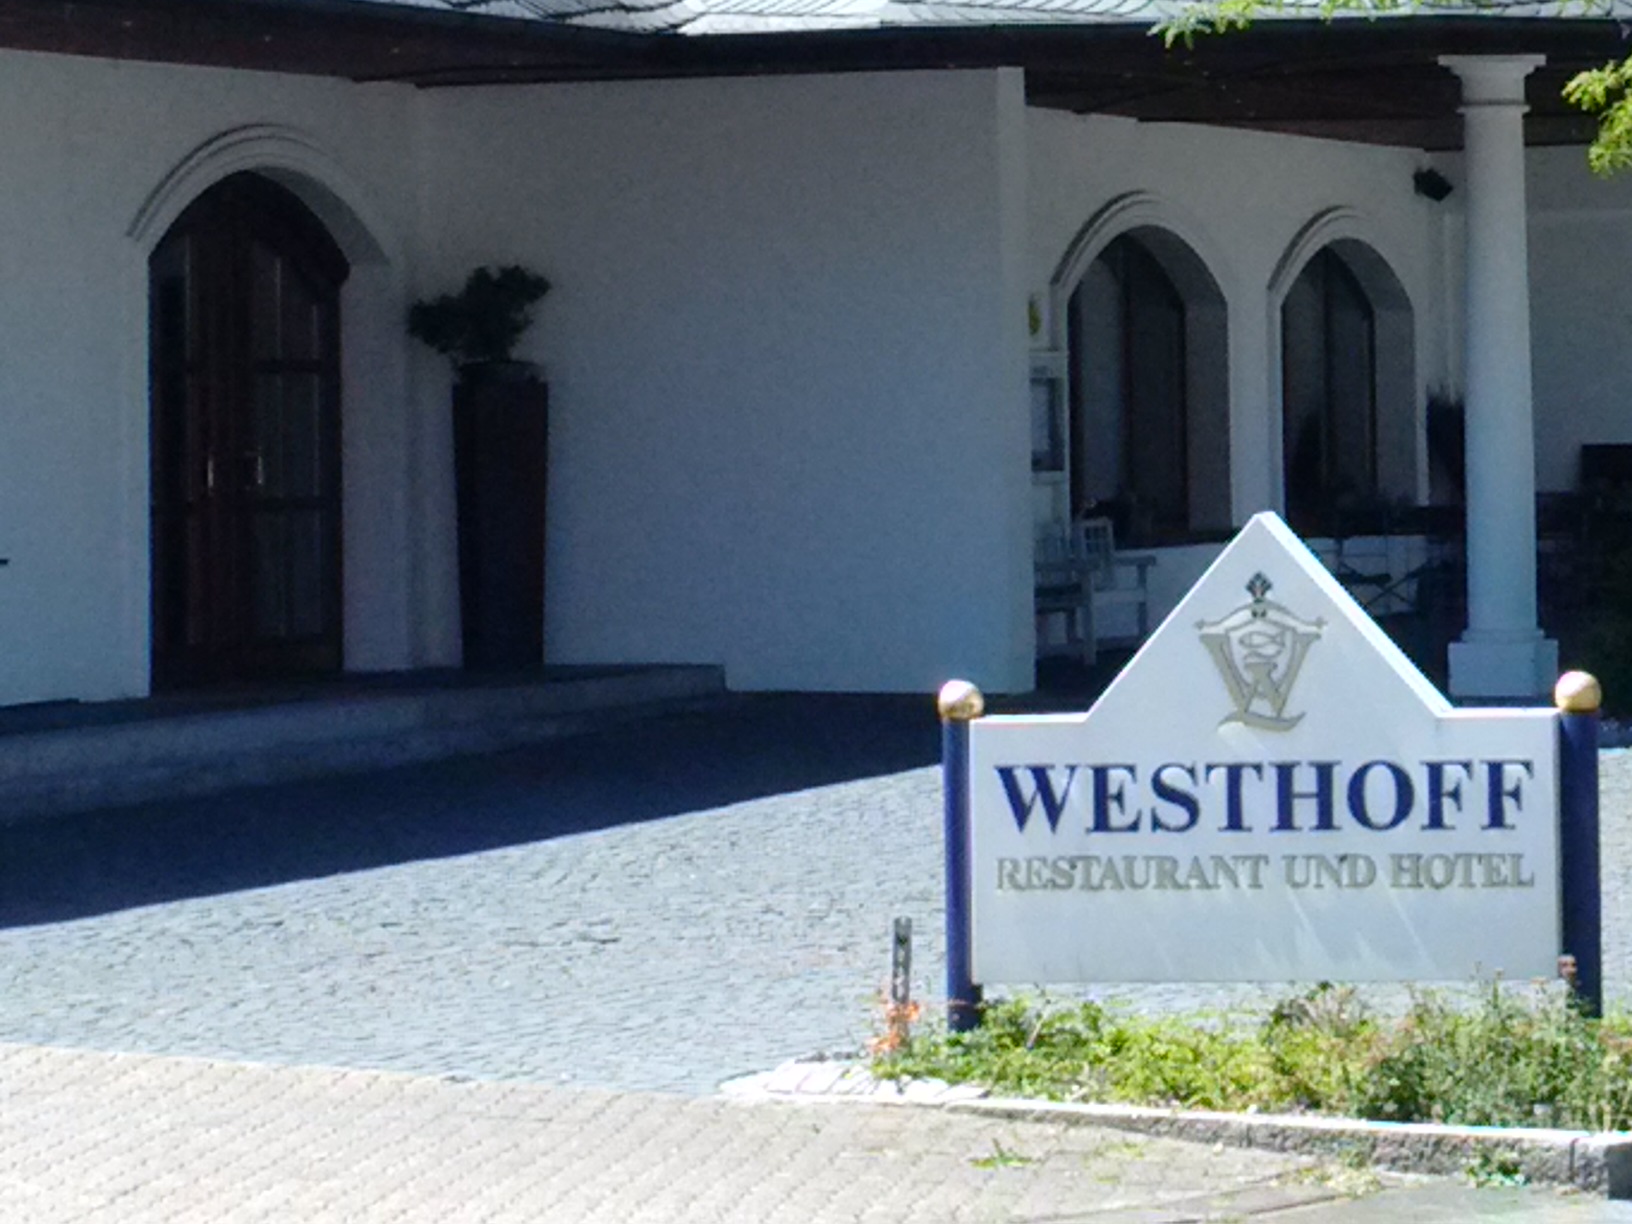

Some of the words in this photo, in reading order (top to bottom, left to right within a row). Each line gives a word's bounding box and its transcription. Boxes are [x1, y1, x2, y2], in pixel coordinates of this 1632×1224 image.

[993, 759, 1535, 836] WESTHOFF
[995, 853, 1271, 892] RESTAURANT
[1281, 852, 1378, 890] UND
[1388, 851, 1535, 891] HOTEL
